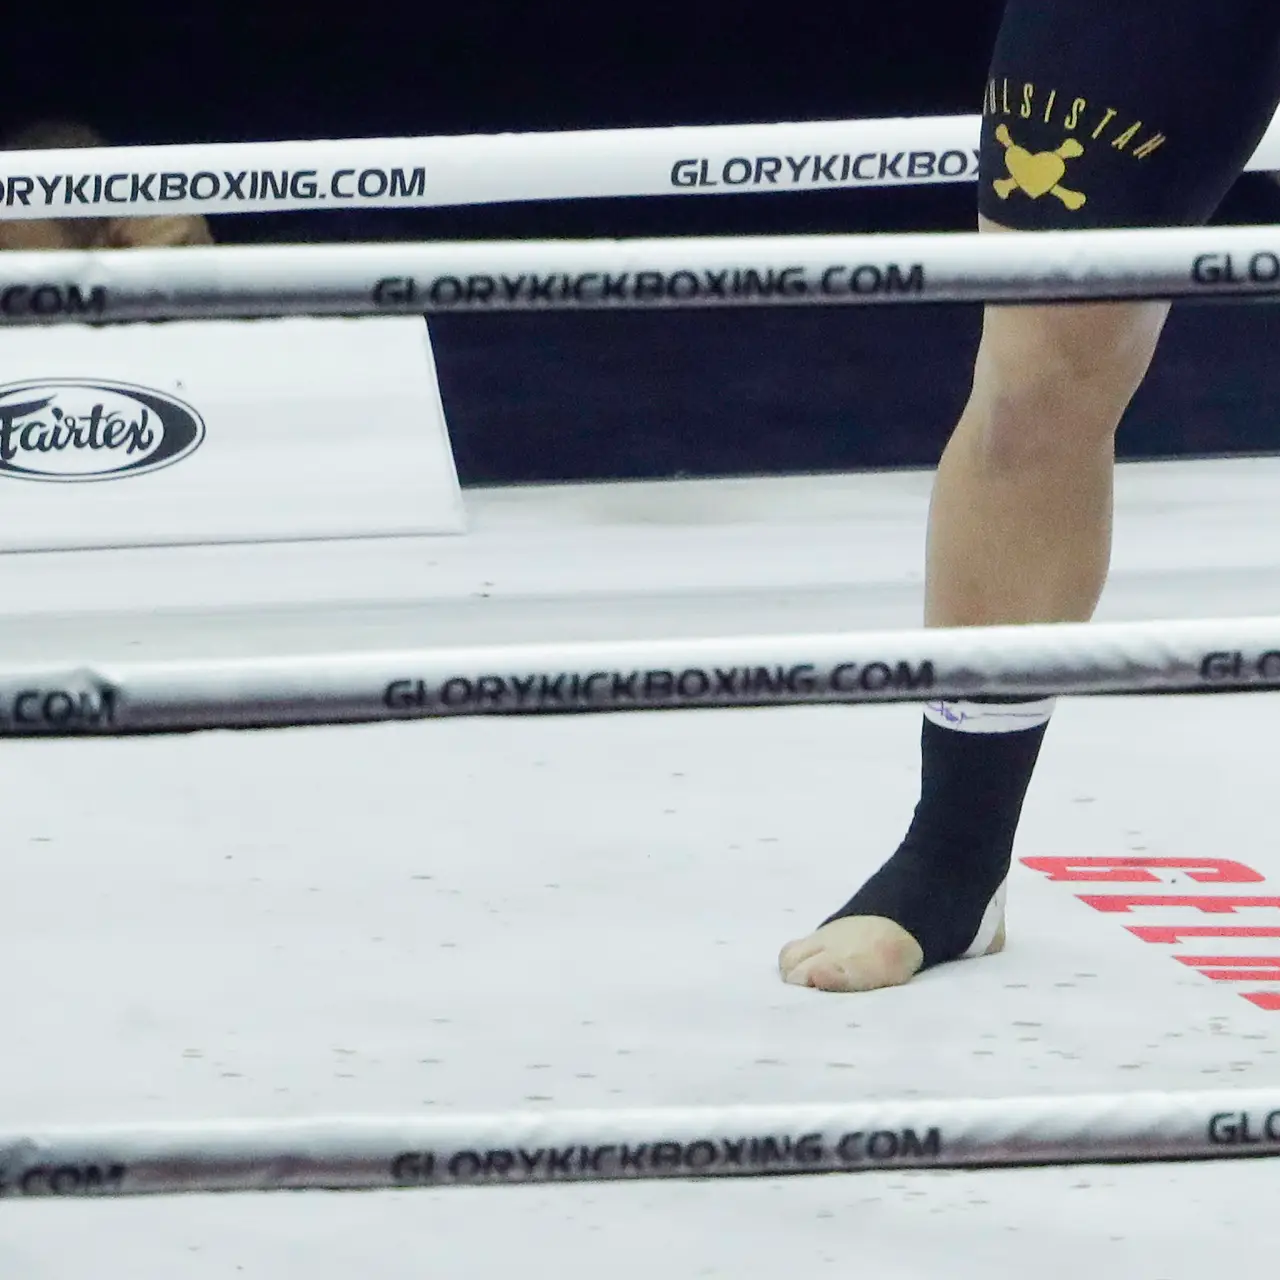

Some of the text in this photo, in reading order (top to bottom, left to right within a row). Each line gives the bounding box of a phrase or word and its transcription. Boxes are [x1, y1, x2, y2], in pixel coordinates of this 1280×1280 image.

[0, 167, 426, 207] RYKICKBOXING.COM
[372, 262, 925, 308] GLORYKICKBOXING.COM
[0, 393, 154, 460] Fairtex
